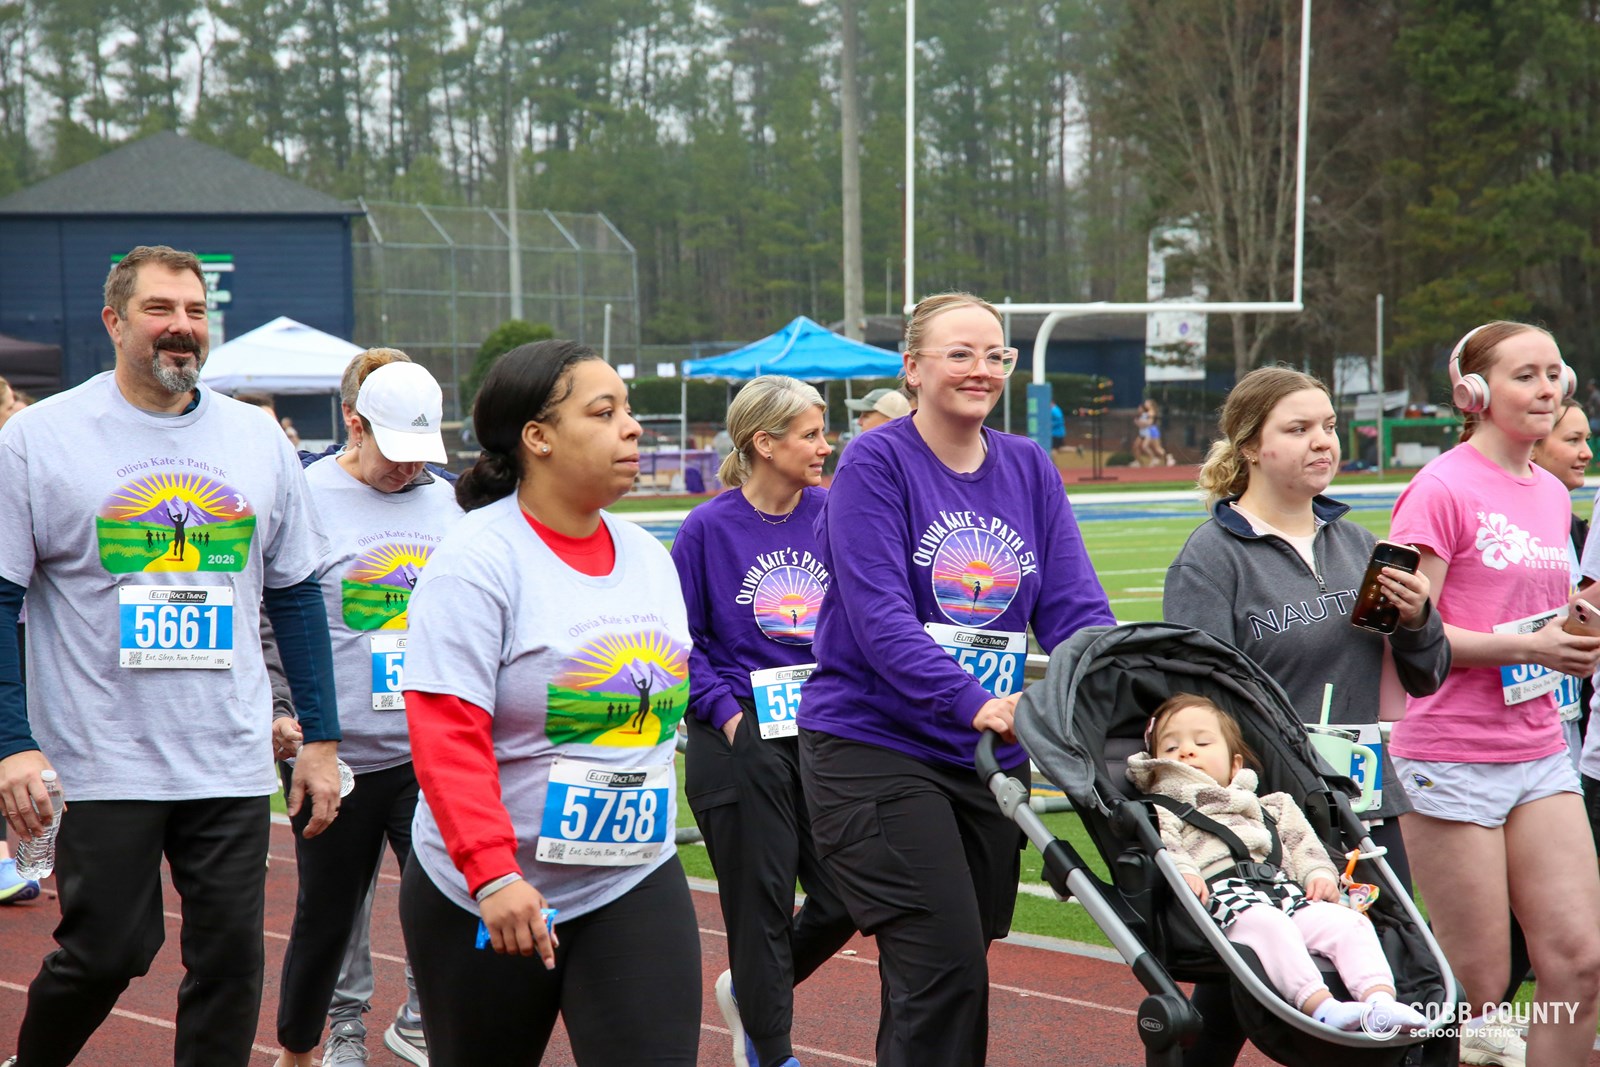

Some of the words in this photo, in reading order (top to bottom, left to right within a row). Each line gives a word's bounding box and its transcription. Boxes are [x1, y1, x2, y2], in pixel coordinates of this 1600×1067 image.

[116, 460, 149, 479] Olivia
[187, 458, 210, 471] Path
[213, 466, 228, 479] 5K
[357, 533, 384, 547] Olivia
[414, 532, 434, 541] Path
[912, 520, 949, 567] OLIVIA
[990, 516, 1025, 552] PATH
[1019, 551, 1037, 577] 5K
[207, 554, 235, 565] 2026
[735, 565, 764, 605] OLIVIA
[800, 551, 829, 582] PATH
[170, 591, 187, 600] RACE
[568, 619, 600, 638] Olivia
[632, 613, 658, 624] Path
[1248, 588, 1358, 641] NAUT
[135, 605, 218, 649] 5661
[956, 633, 974, 643] ELITE
[974, 634, 990, 645] RACE
[590, 773, 610, 782] ELITE
[611, 774, 629, 783] RACE
[560, 786, 657, 842] 5758
